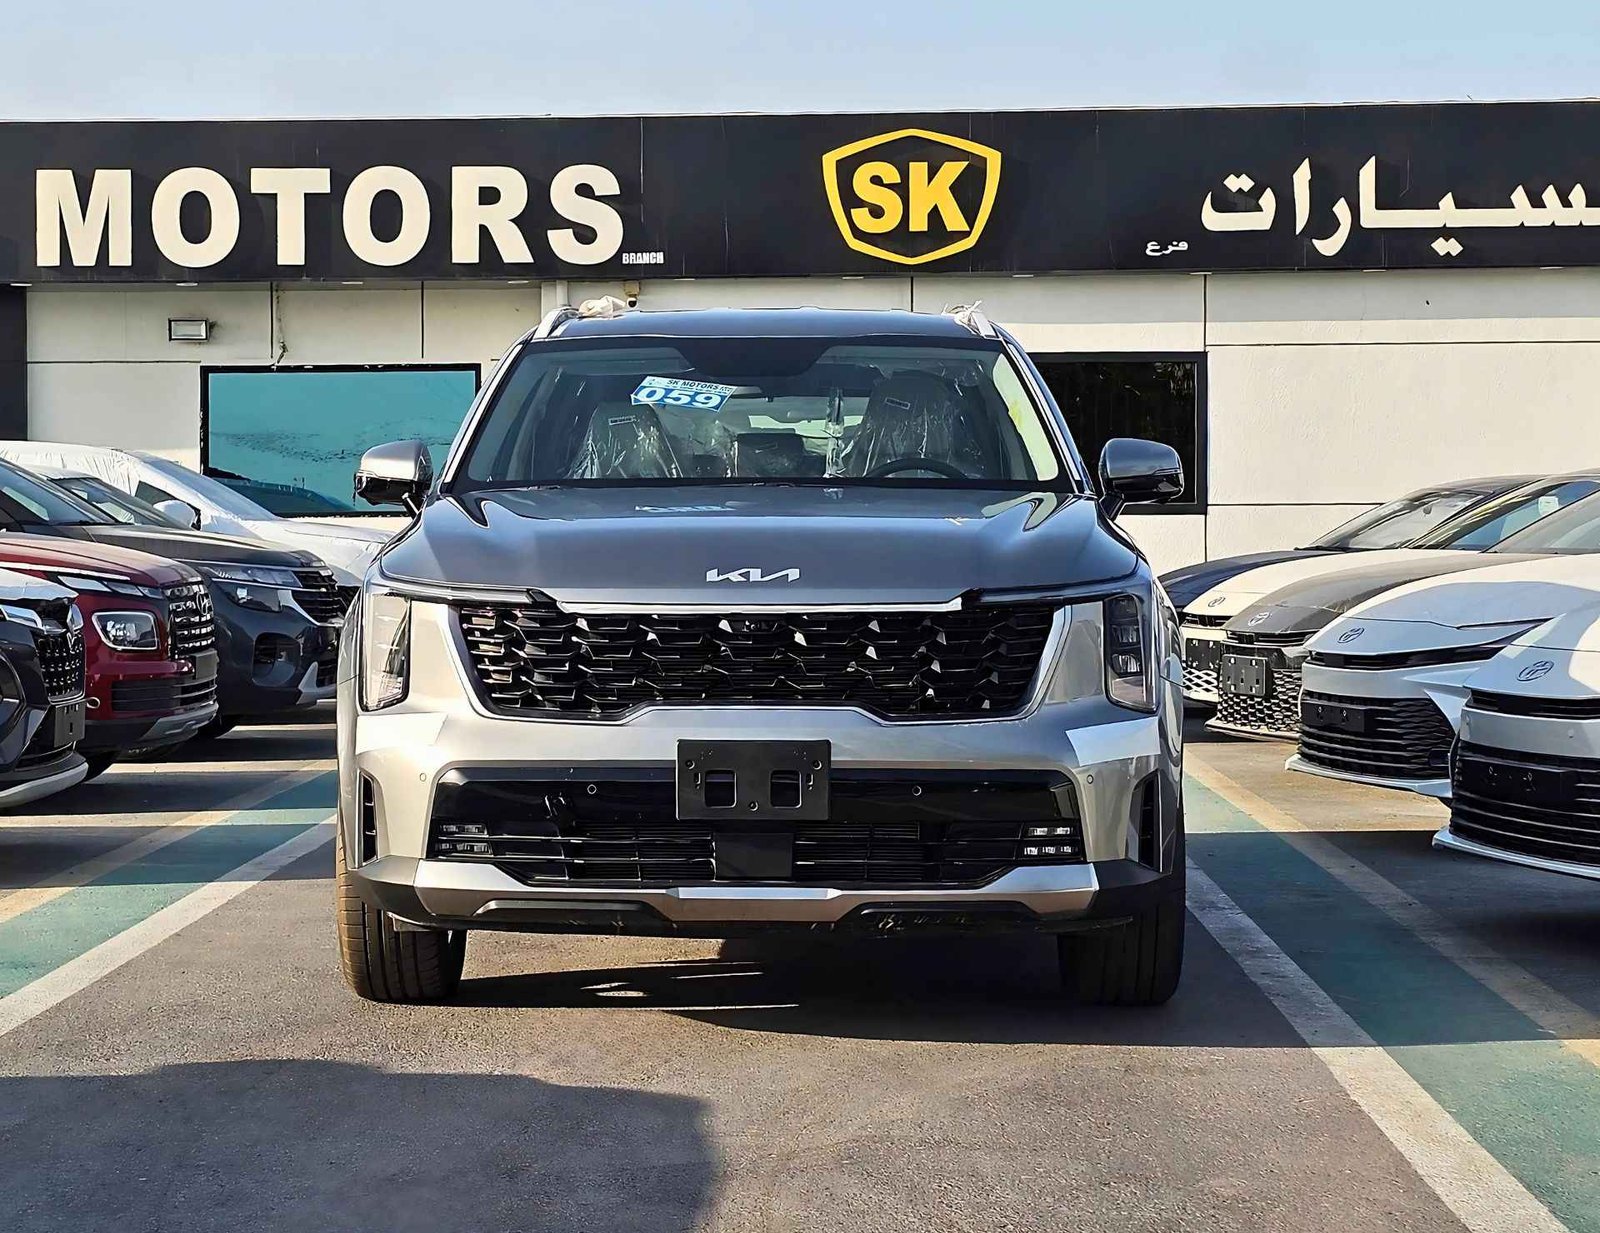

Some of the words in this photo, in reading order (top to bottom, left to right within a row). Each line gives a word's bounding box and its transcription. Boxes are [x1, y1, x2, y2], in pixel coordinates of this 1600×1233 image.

[850, 161, 971, 233] SK
[1202, 156, 1600, 257] سيارات
[36, 165, 624, 267] MOTORS
[622, 251, 664, 264] BRANCH
[1145, 241, 1189, 256] فرع
[681, 380, 720, 390] MOTORS
[636, 387, 721, 408] 059
